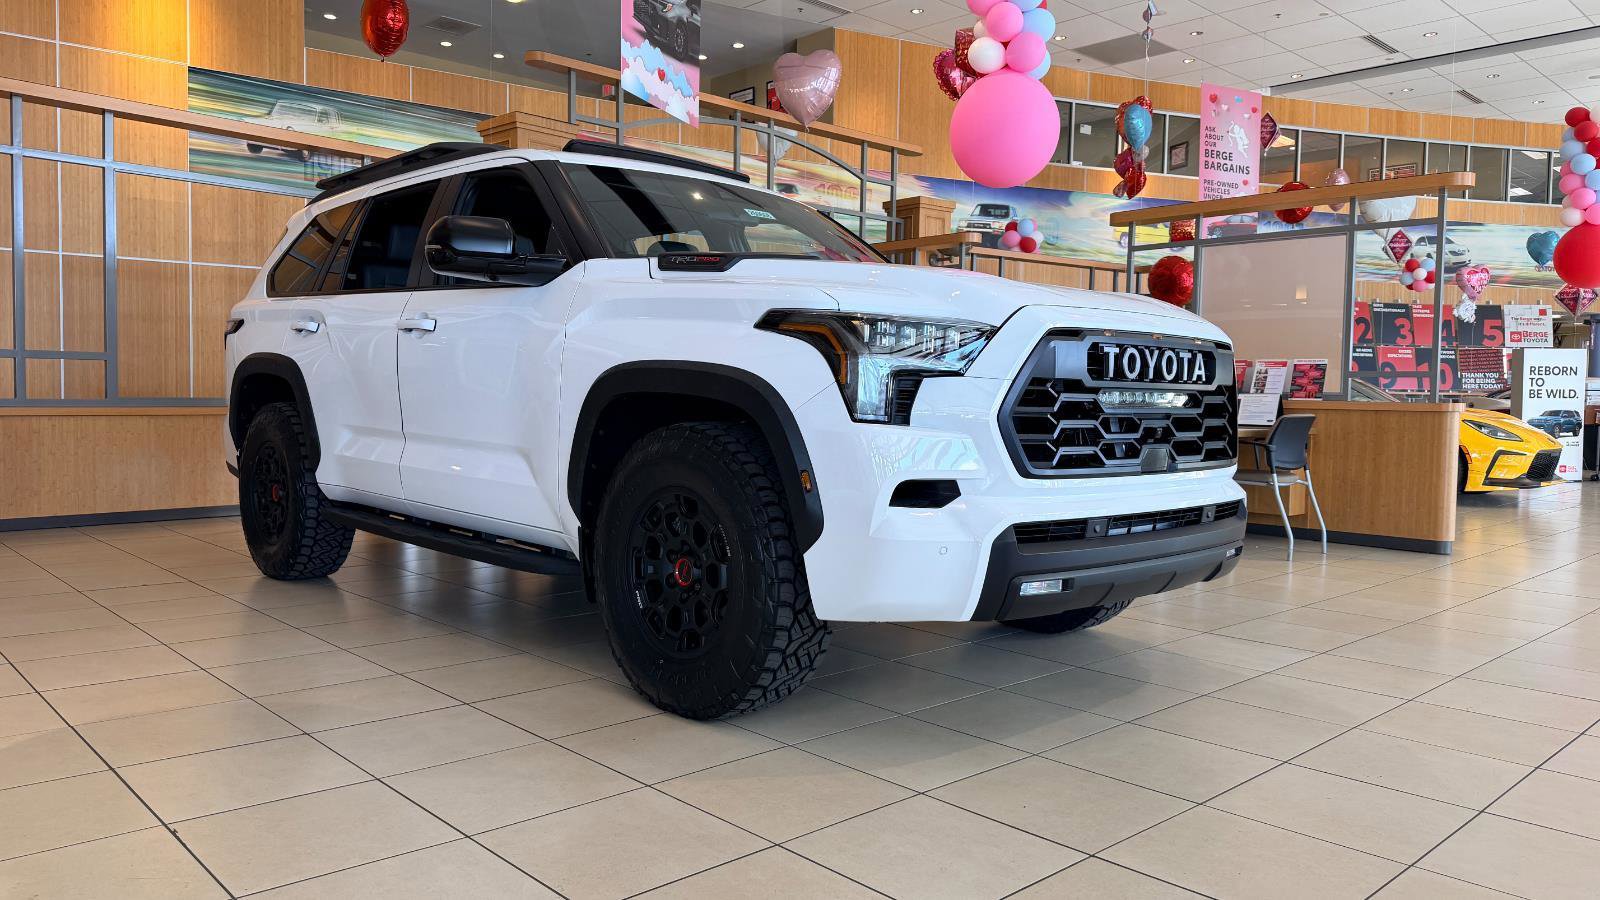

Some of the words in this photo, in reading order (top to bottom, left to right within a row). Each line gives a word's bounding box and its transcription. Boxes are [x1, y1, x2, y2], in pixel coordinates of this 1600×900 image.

[1204, 133, 1224, 141] ABOUT
[1204, 140, 1217, 148] OUR
[1204, 148, 1233, 161] BERGE
[1204, 160, 1250, 175] BARGAINS
[1203, 179, 1239, 189] PRE-OWNED
[1203, 186, 1230, 195] VEHICLES
[1354, 317, 1373, 345] 2
[1394, 317, 1412, 345] 3
[1482, 319, 1504, 347] 5
[1522, 330, 1548, 338] BERGE
[1103, 345, 1206, 382] TOYOTA
[1380, 361, 1397, 389] 9
[1529, 366, 1578, 376] REBORN
[1528, 377, 1545, 387] TO
[1528, 389, 1542, 399] BE
[1545, 389, 1579, 399] WILD.
